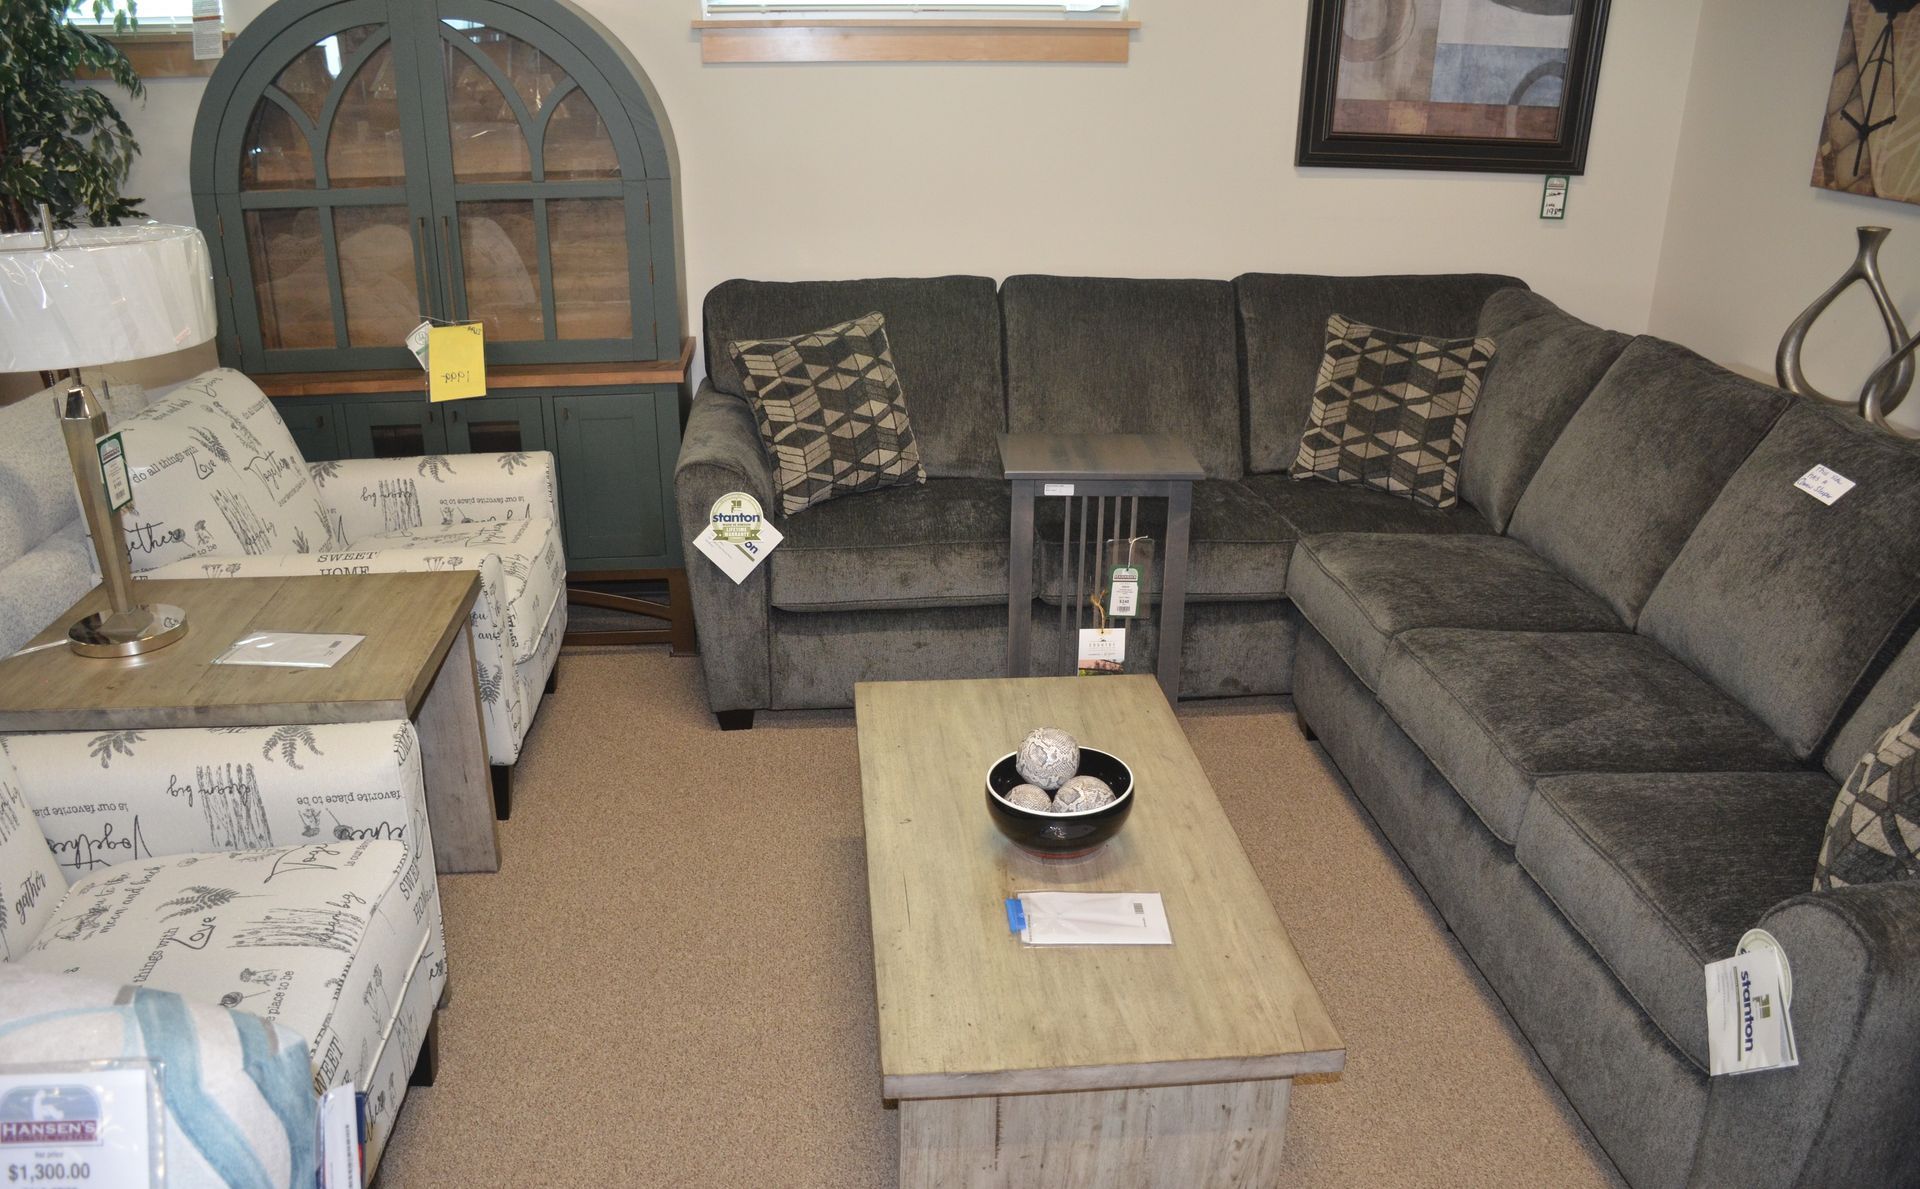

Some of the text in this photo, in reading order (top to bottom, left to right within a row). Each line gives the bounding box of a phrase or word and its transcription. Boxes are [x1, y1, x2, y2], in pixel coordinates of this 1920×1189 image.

[132, 469, 147, 484] do
[146, 458, 162, 477] all
[158, 451, 185, 470] things
[713, 513, 760, 522] stanton
[316, 551, 378, 563] SWEET
[166, 774, 193, 808] big
[297, 790, 401, 806] favorite place to be
[32, 807, 50, 817] pla
[52, 804, 96, 815] favorite
[118, 803, 129, 812] is
[122, 886, 145, 905] and
[166, 916, 217, 950] Love
[284, 970, 294, 981] be
[280, 980, 290, 992] to
[268, 991, 286, 1016] place
[1740, 970, 1755, 1052] stanton
[314, 1034, 345, 1097] WEET
[3, 1122, 96, 1136] HANSEN'S
[9, 1163, 90, 1182] $1,300.00
